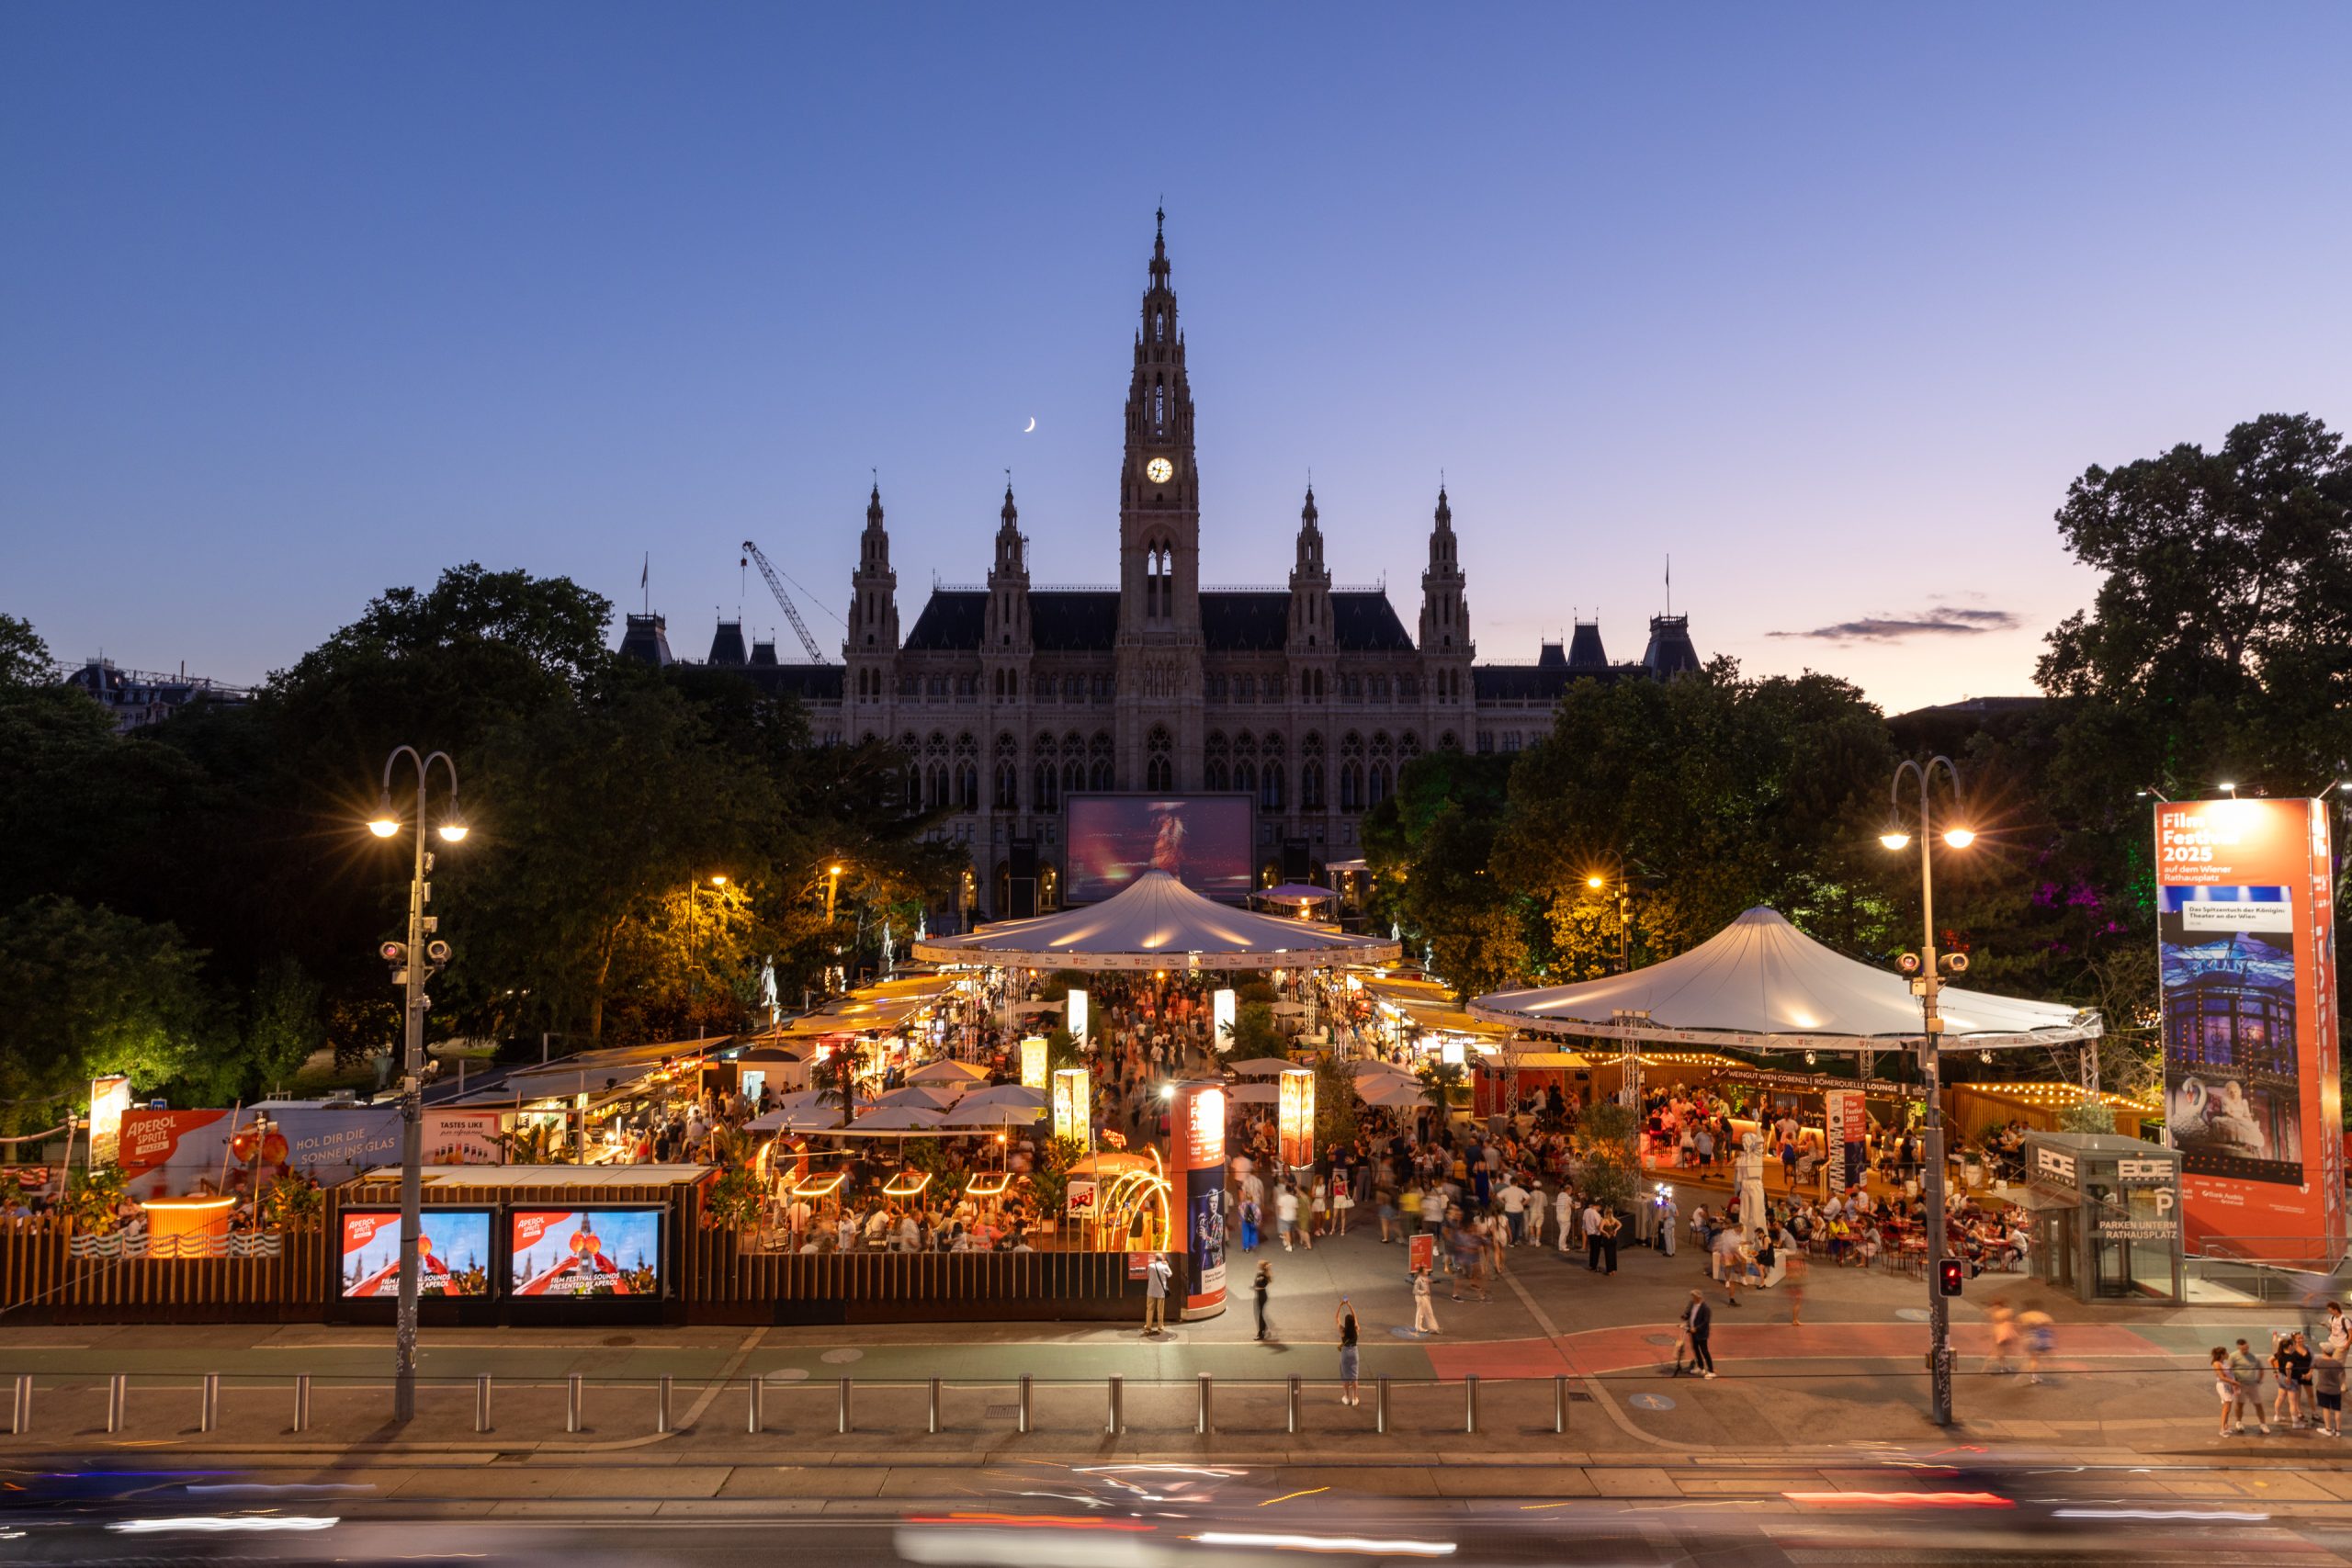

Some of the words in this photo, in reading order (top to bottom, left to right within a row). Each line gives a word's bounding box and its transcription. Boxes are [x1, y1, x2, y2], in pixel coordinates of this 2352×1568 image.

[2163, 813, 2206, 829] Film
[2163, 829, 2240, 845] Festiv
[2163, 847, 2213, 862] 2025
[2164, 865, 2178, 874] auf
[2179, 865, 2199, 874] dem
[2199, 865, 2233, 874] Wiener
[2164, 874, 2220, 883] Rathausplatz
[2315, 924, 2329, 1075] estival
[1728, 1070, 1758, 1080] WEINGUT
[1758, 1073, 1777, 1082] WIEN
[1778, 1075, 1809, 1085] COBENZL
[1814, 1077, 1866, 1089] RÖMERQUELLE
[1866, 1083, 1898, 1092] LOUNGE
[1845, 1107, 1863, 1115] Festival
[127, 1115, 177, 1138] APEROL
[467, 1121, 483, 1129] LIKE
[138, 1130, 168, 1145] SPRITZ
[297, 1136, 320, 1151] HOL
[323, 1133, 344, 1145] DIR
[347, 1128, 366, 1141] DIE
[300, 1150, 341, 1165] SONNE
[345, 1145, 363, 1158] INS
[366, 1137, 395, 1153] GLAS
[2038, 1147, 2075, 1179] BOE
[2118, 1159, 2174, 1178] BOE
[1070, 1186, 1094, 1211] NRJ
[2156, 1193, 2174, 1216] P
[348, 1217, 376, 1230] APEROL
[517, 1216, 545, 1229] APEROL
[2099, 1221, 2137, 1230] PARKEN
[2139, 1221, 2177, 1229] UNTERM
[2106, 1230, 2177, 1239] RATHAUSPLATZ
[424, 1273, 451, 1281] SOUNDS
[566, 1274, 593, 1283] FESTIVAL
[594, 1272, 620, 1280] SOUNDS
[549, 1281, 583, 1291] PRESENTED
